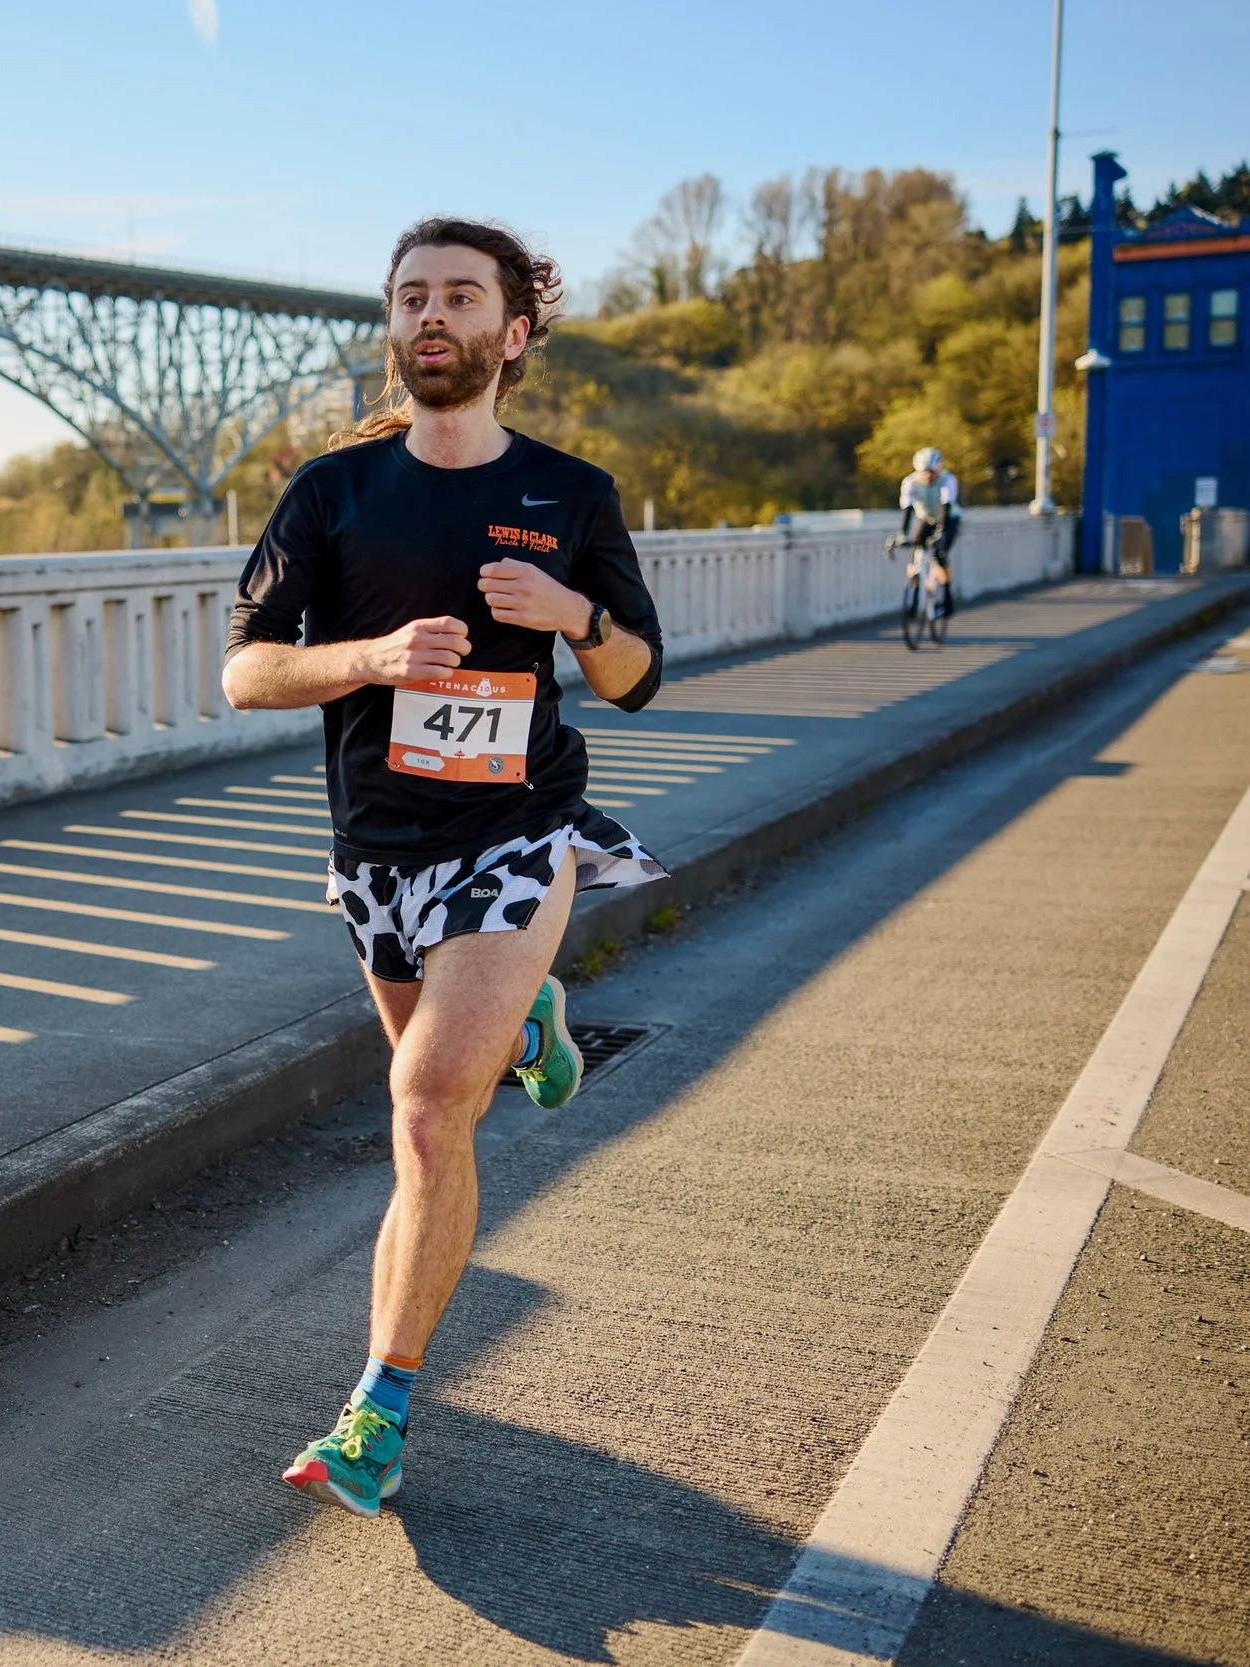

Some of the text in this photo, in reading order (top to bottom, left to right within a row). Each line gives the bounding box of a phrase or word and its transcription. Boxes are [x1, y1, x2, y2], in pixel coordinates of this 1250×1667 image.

[488, 525, 558, 549] LEWIS & CLARK
[423, 703, 502, 743] 471
[416, 758, 431, 766] 10K
